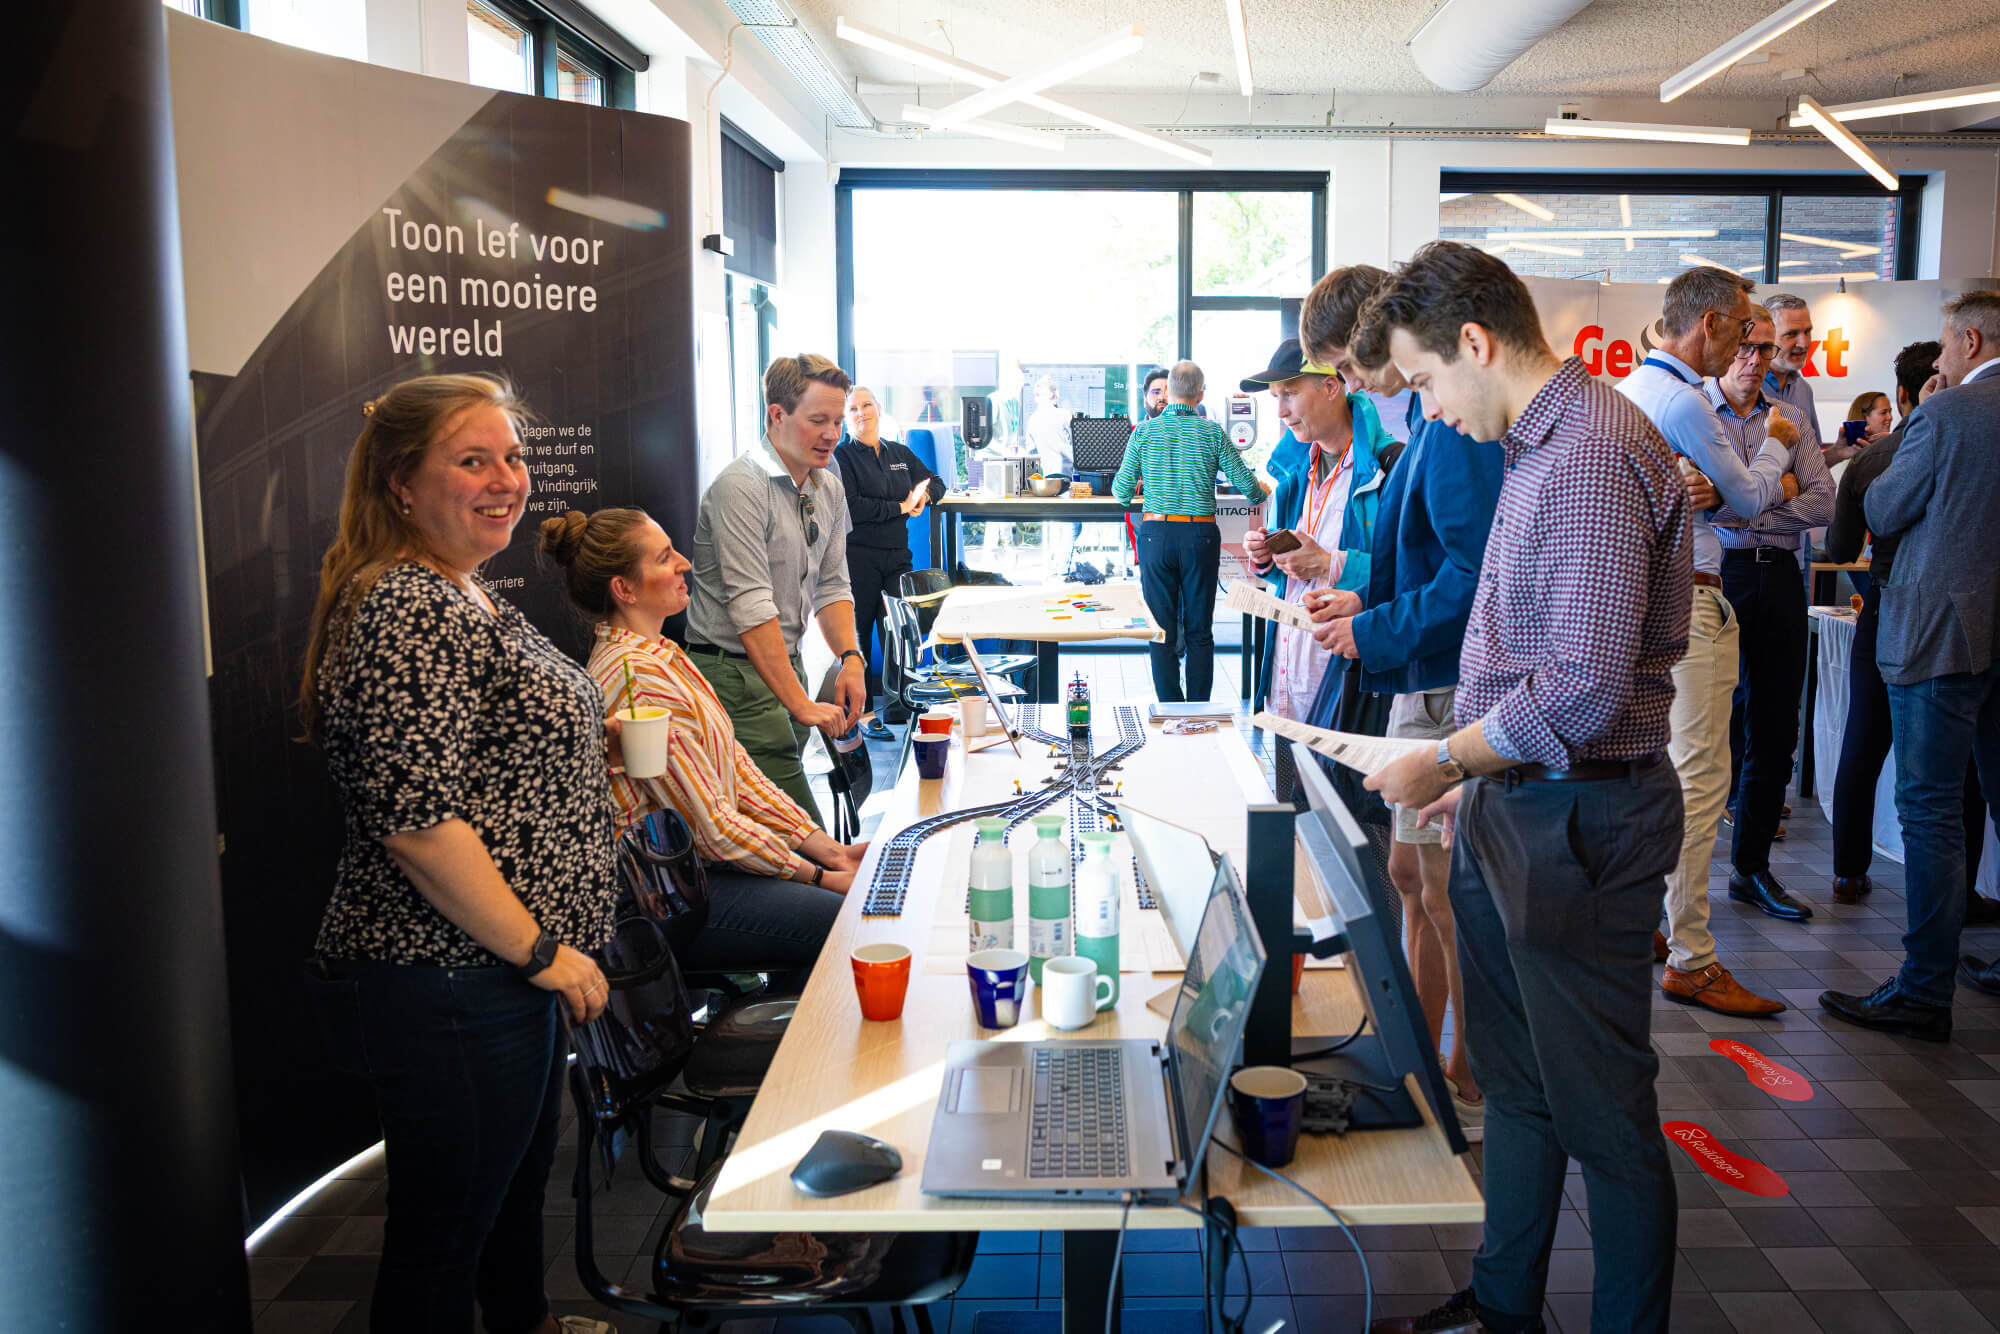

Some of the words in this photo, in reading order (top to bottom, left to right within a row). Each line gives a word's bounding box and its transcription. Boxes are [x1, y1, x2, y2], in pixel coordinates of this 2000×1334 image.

[383, 207, 464, 255] Toon
[477, 218, 519, 259] lef
[530, 233, 604, 266] voor
[387, 271, 447, 305] een
[460, 273, 598, 313] mooiere
[388, 318, 503, 358] wereld
[521, 424, 556, 440] dagen
[558, 427, 575, 437] we
[577, 424, 592, 437] de
[520, 445, 533, 456] en
[536, 445, 552, 456] we
[554, 442, 578, 456] durf
[580, 444, 594, 455] en
[528, 461, 578, 477] ruitgang.
[537, 478, 599, 494] Vindingrijk
[528, 501, 545, 512] we
[547, 498, 571, 513] zijn.
[489, 575, 525, 590] arriere
[1731, 1044, 1780, 1077] Raildagen
[1688, 1140, 1745, 1180] Raildagen
